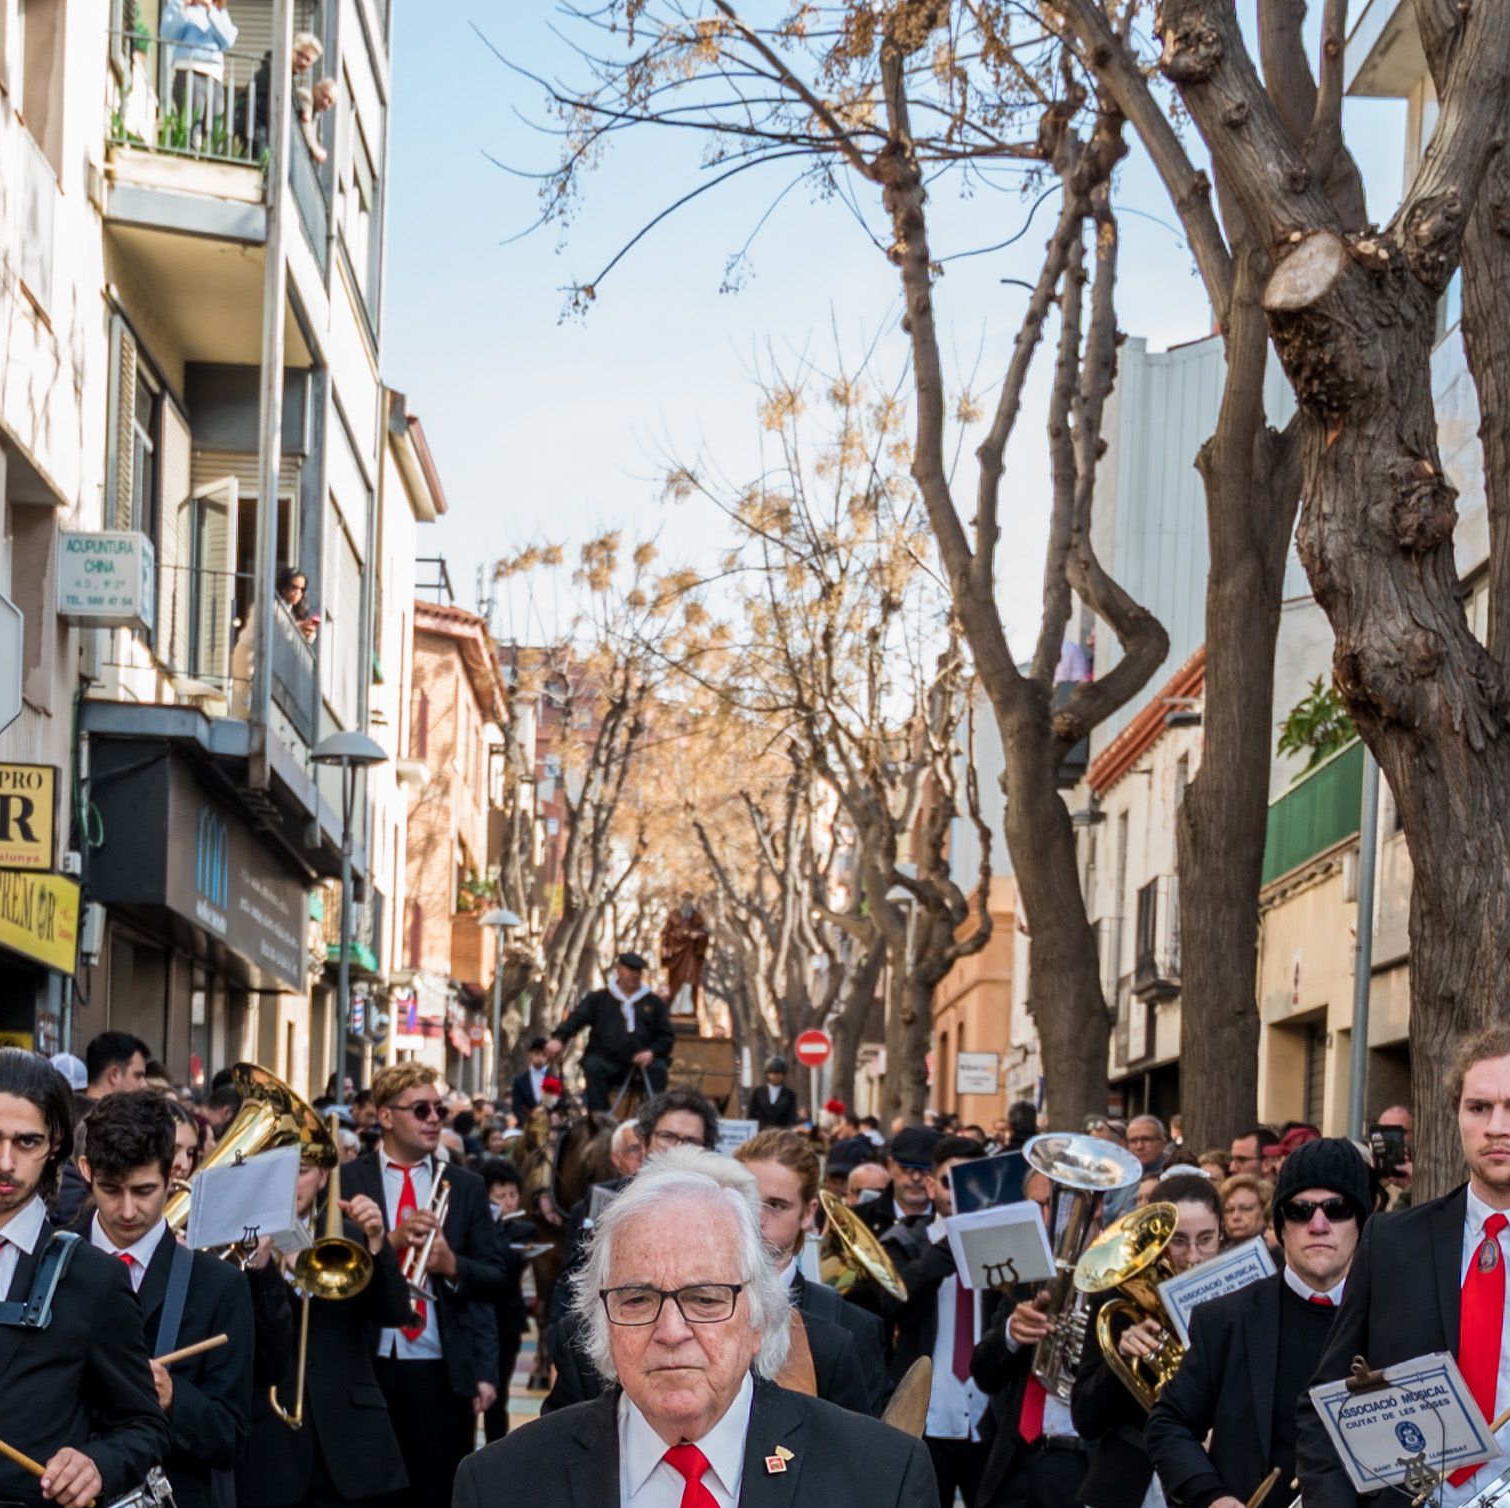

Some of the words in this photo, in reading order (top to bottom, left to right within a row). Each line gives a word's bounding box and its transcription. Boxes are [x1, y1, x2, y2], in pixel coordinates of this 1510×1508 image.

[66, 539, 134, 555] ACUPUNTURA
[84, 560, 115, 574] CHINA
[1224, 1262, 1258, 1283] MUSICAL
[1340, 1396, 1398, 1420] ASSOCIACIÓ
[1401, 1385, 1449, 1405] MUSICAL
[1345, 1416, 1378, 1430] CIUTAT
[1382, 1411, 1396, 1421] DE
[1399, 1407, 1416, 1417] LES
[1420, 1398, 1451, 1411] ROSES
